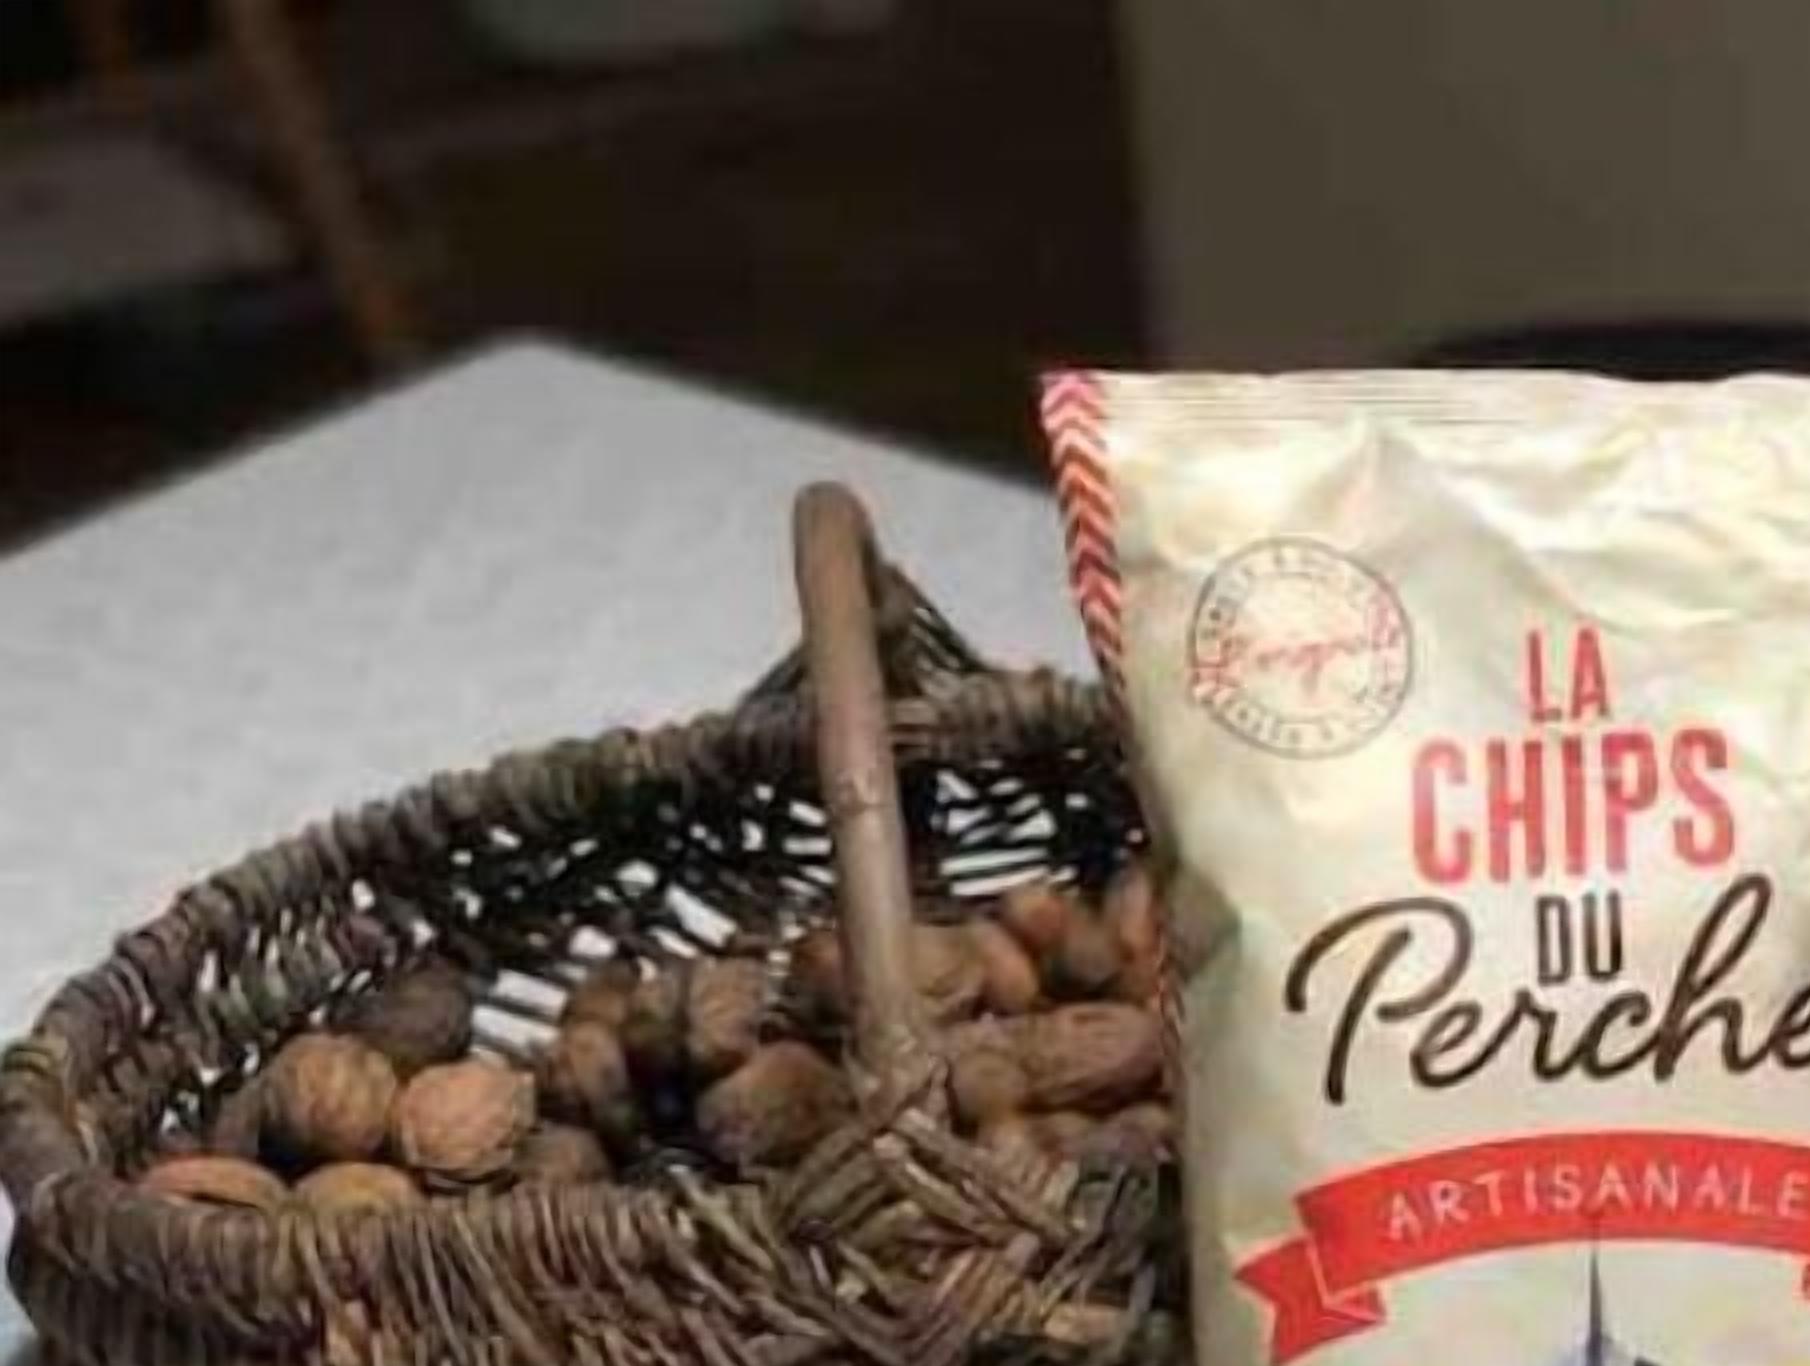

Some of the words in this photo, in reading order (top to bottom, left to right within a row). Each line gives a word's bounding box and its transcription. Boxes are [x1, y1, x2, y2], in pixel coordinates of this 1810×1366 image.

[1526, 626, 1612, 720] LA
[1411, 726, 1736, 884] CHIPS
[1537, 890, 1624, 986] DU
